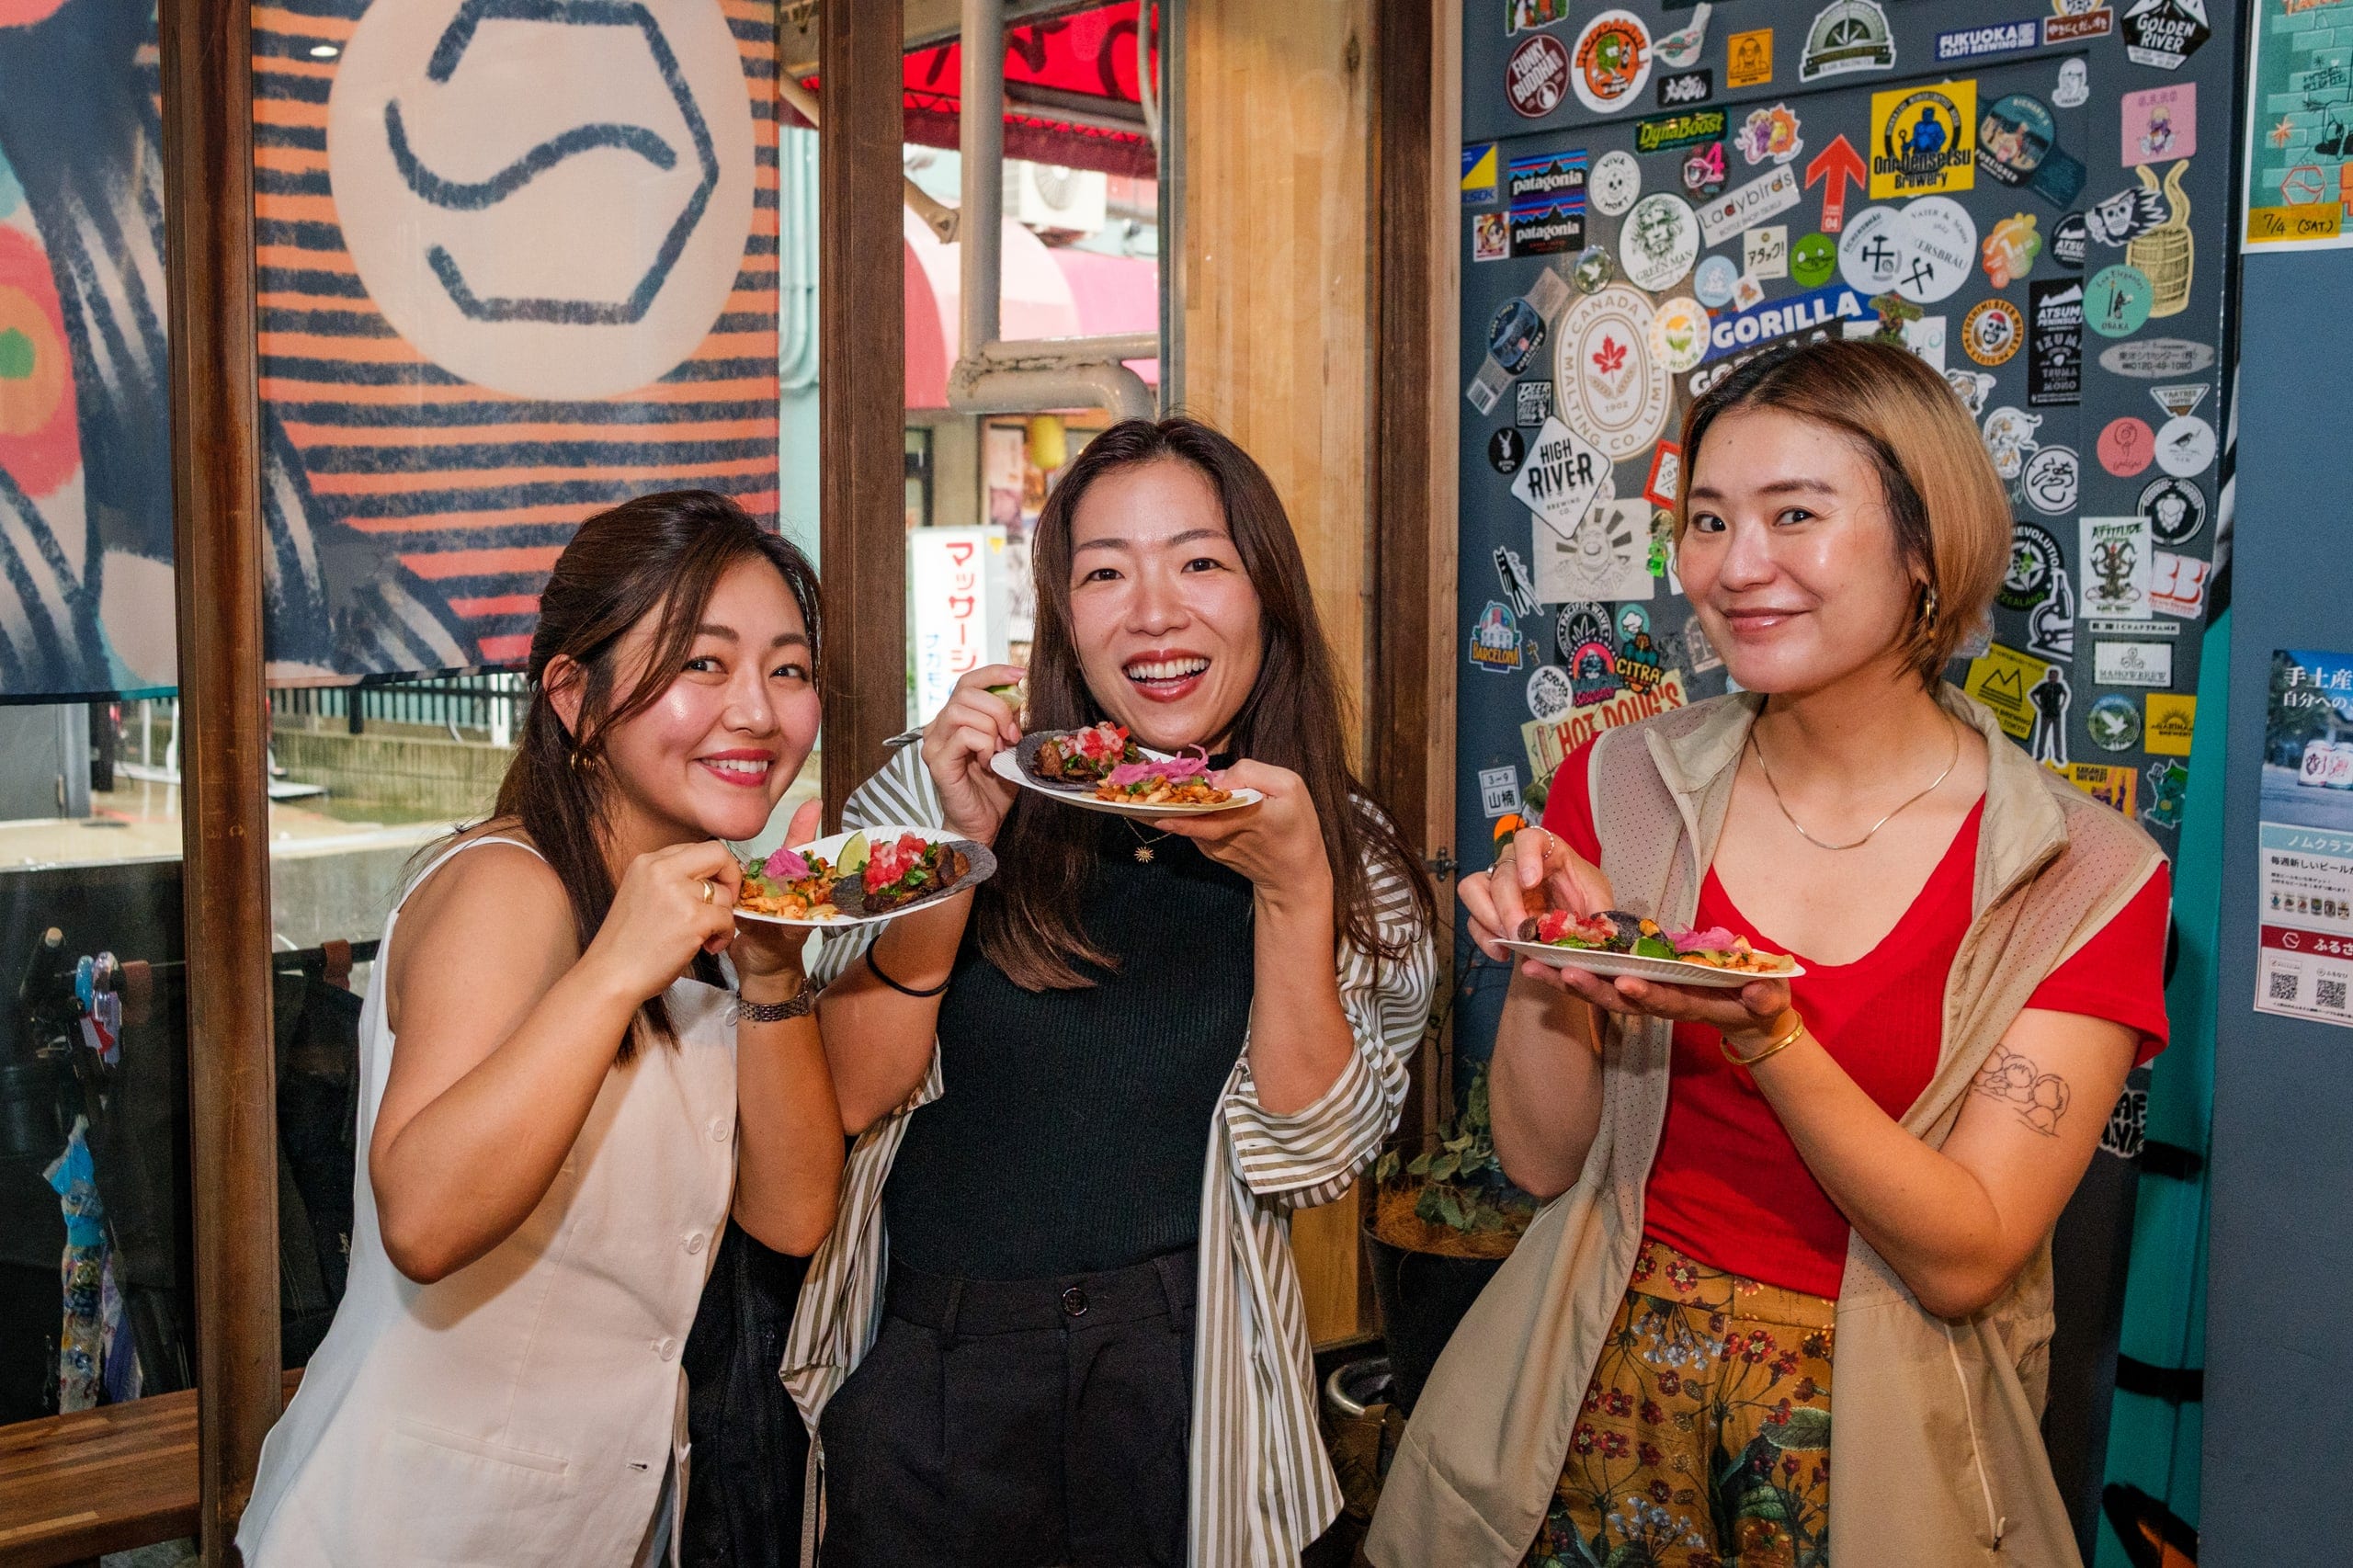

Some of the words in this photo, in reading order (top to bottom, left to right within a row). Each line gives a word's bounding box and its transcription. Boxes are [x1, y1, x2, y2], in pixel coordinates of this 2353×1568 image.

[1939, 26, 2018, 49] FUKUOKA
[2137, 13, 2197, 37] GOLDEN
[1939, 47, 1969, 58] CRAFT
[1971, 40, 2018, 54] BREWING
[2140, 31, 2185, 53] RIVER
[1512, 38, 1547, 79] FUNKY
[1512, 53, 1559, 104] BUDDHA
[1513, 171, 1583, 195] patagonia
[1699, 173, 1792, 229] Ladybirds
[1516, 222, 1580, 244] patagonia
[2263, 213, 2286, 234] 7/4
[1572, 295, 1639, 335] CANADA
[1712, 290, 1862, 348] GORILLA
[2039, 305, 2082, 319] ATSUM
[1564, 356, 1602, 447] MALTING
[1540, 437, 1572, 464] HIGH
[1528, 452, 1594, 500] RIVER
[1547, 497, 1580, 510] BREWING
[1562, 602, 1591, 627] PACIFIC
[1591, 604, 1609, 629] WAVE
[1472, 641, 1519, 666] BARCELONA
[1617, 658, 1661, 684] CITRA
[2285, 665, 2353, 690] 手土産
[2283, 691, 2353, 709] 自分への
[1555, 713, 1597, 757] HOT
